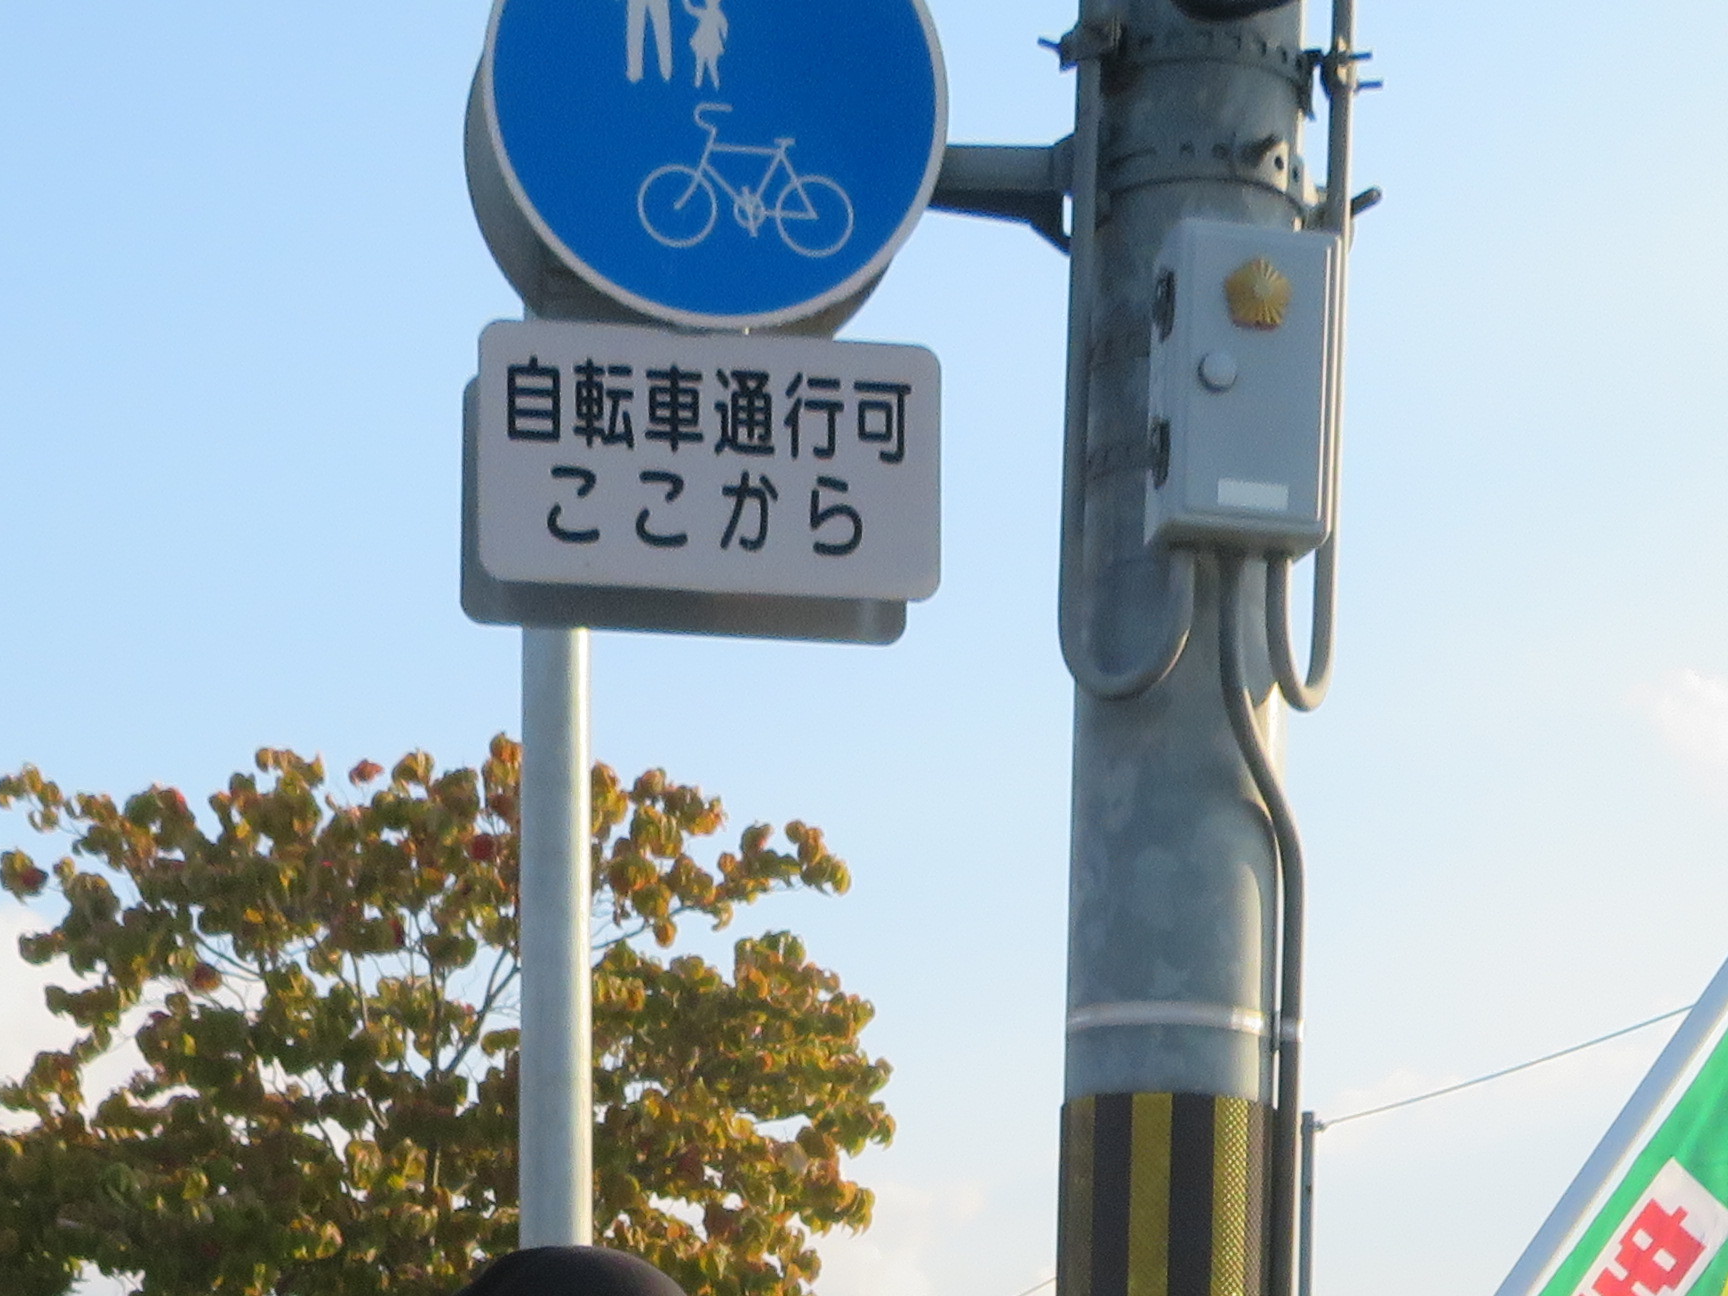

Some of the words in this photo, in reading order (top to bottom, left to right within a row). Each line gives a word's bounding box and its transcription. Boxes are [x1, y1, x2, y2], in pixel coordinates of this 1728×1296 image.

[506, 355, 913, 466] 自転車通行可
[545, 466, 865, 557] ここから
